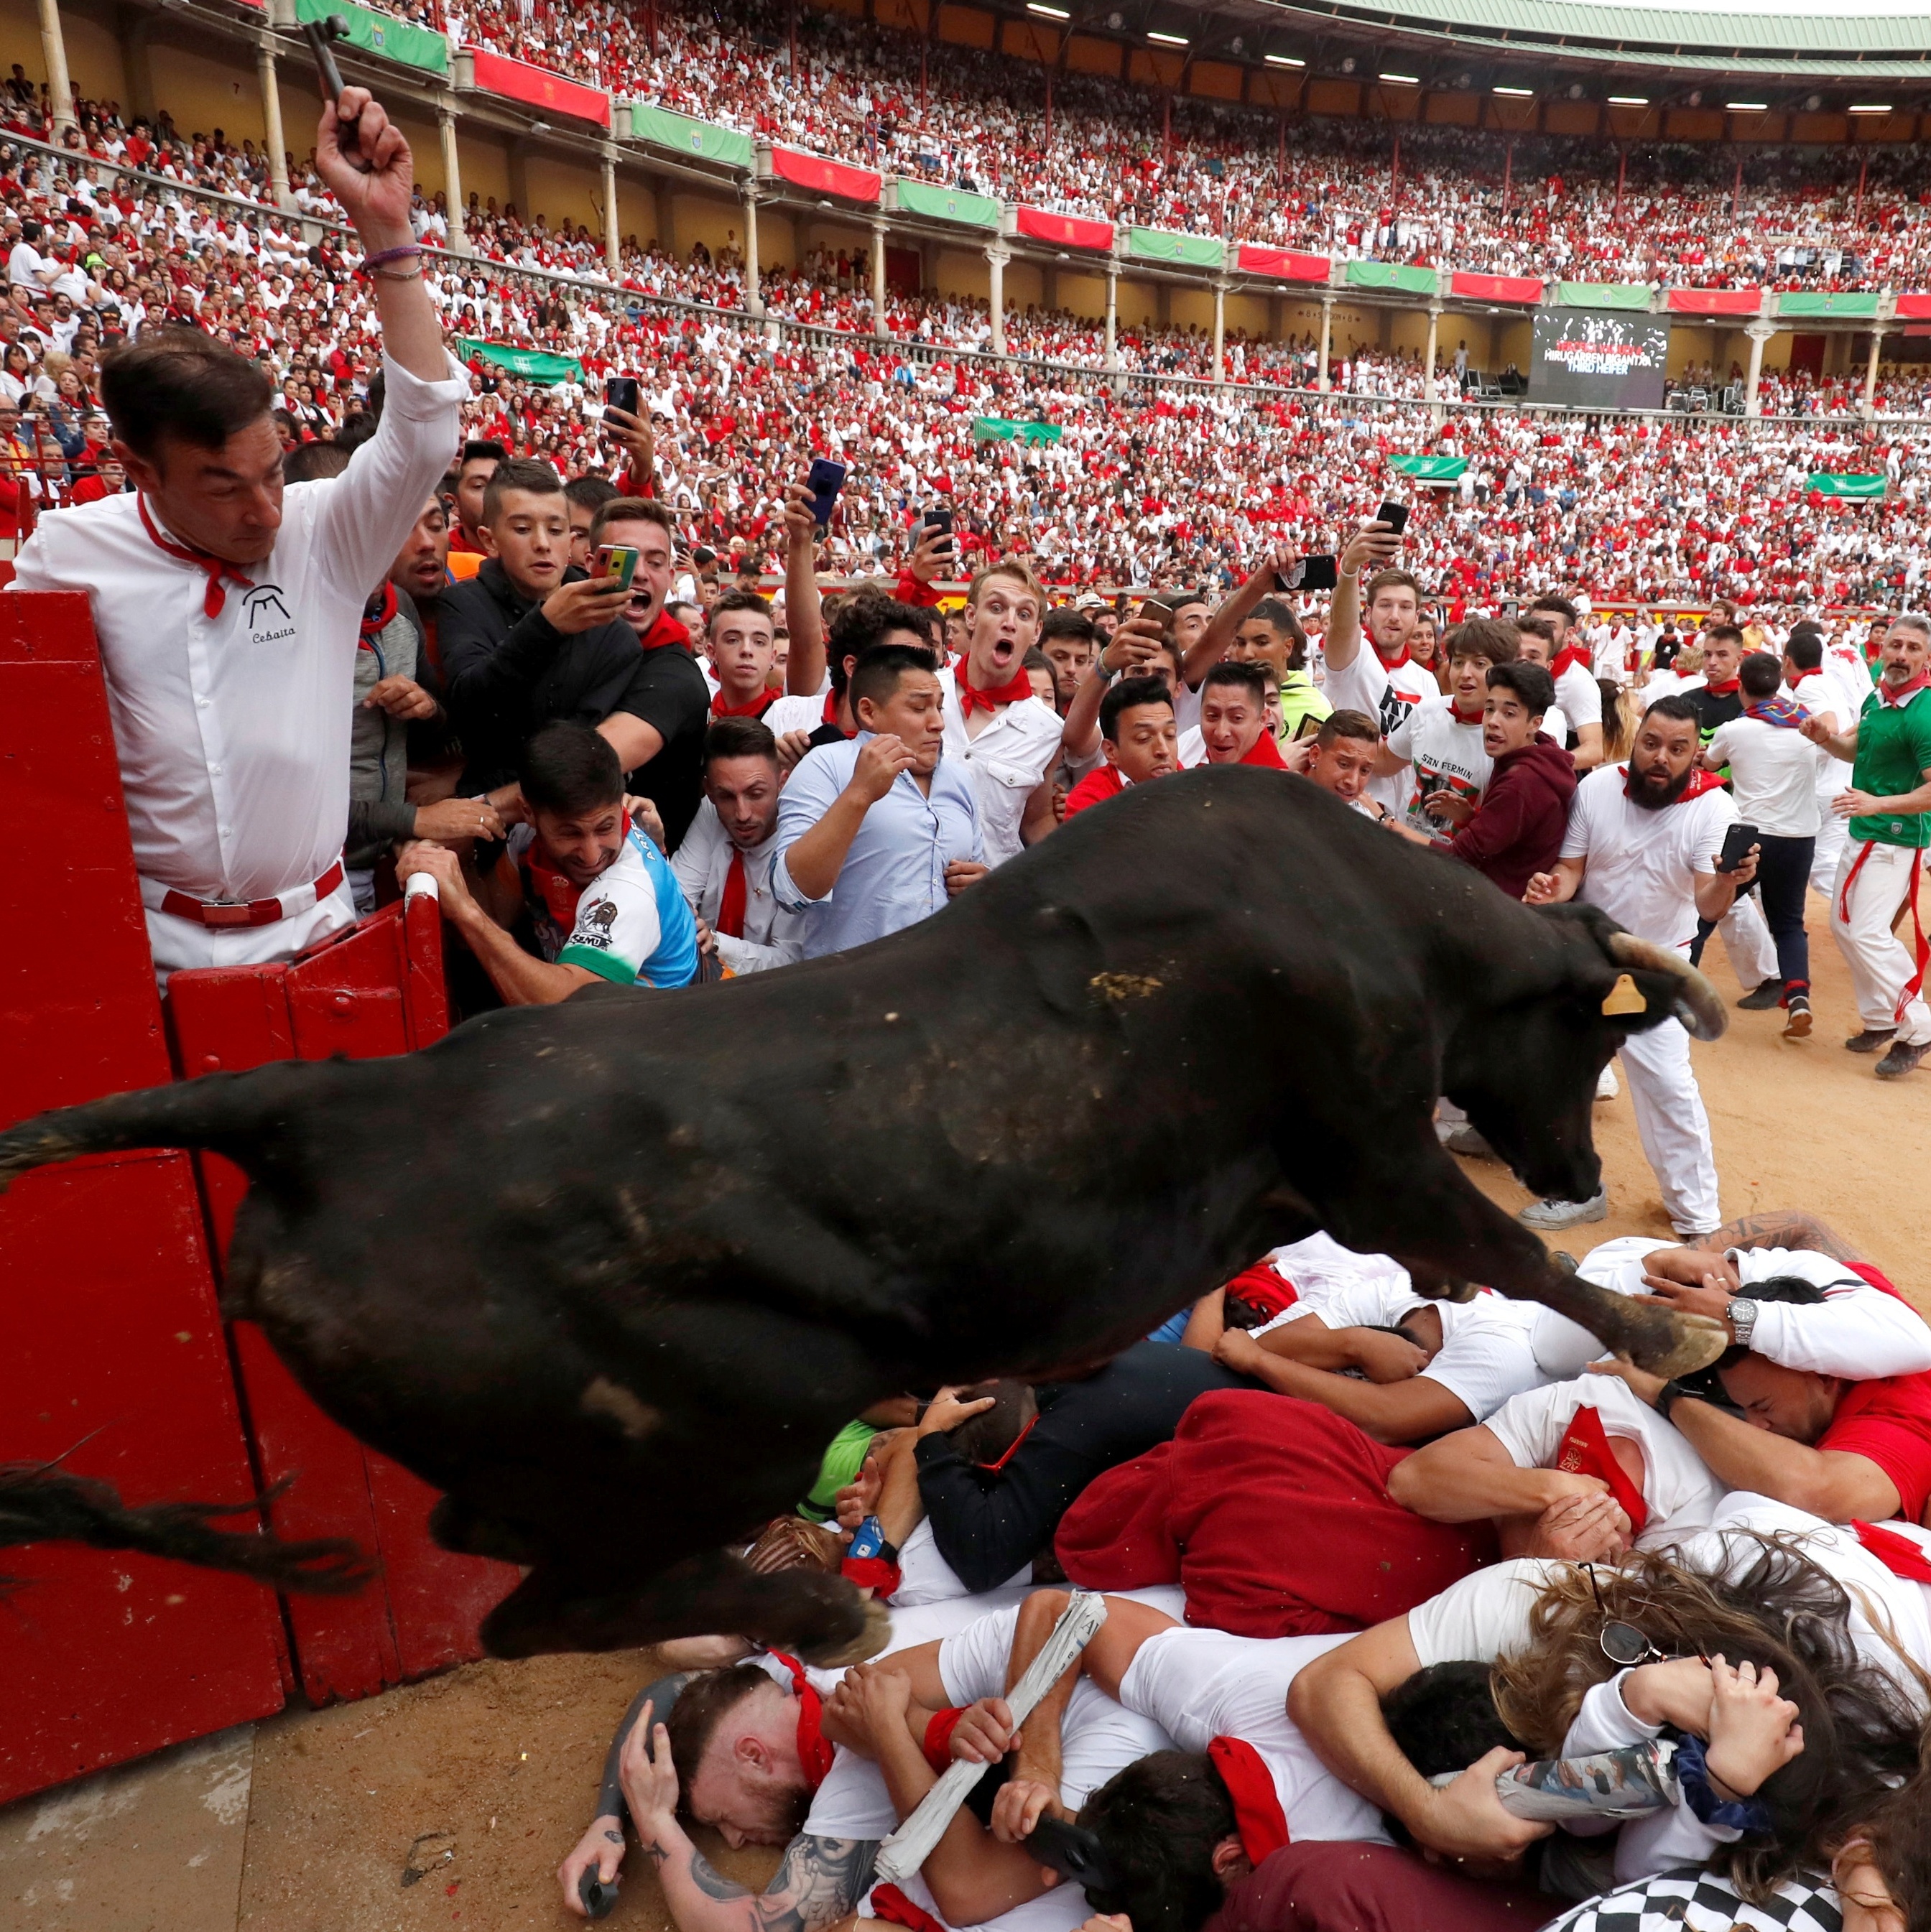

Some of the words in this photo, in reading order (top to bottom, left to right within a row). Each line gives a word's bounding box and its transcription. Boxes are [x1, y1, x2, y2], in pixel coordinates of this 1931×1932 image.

[233, 82, 240, 95] 7
[1544, 349, 1605, 364] HIRUGARREN
[1605, 353, 1652, 367] BIGANTXA
[1567, 361, 1596, 374] THIRD
[1596, 362, 1629, 376] HEIFER
[1421, 753, 1439, 768] SAN
[1441, 761, 1473, 780] FERMIN
